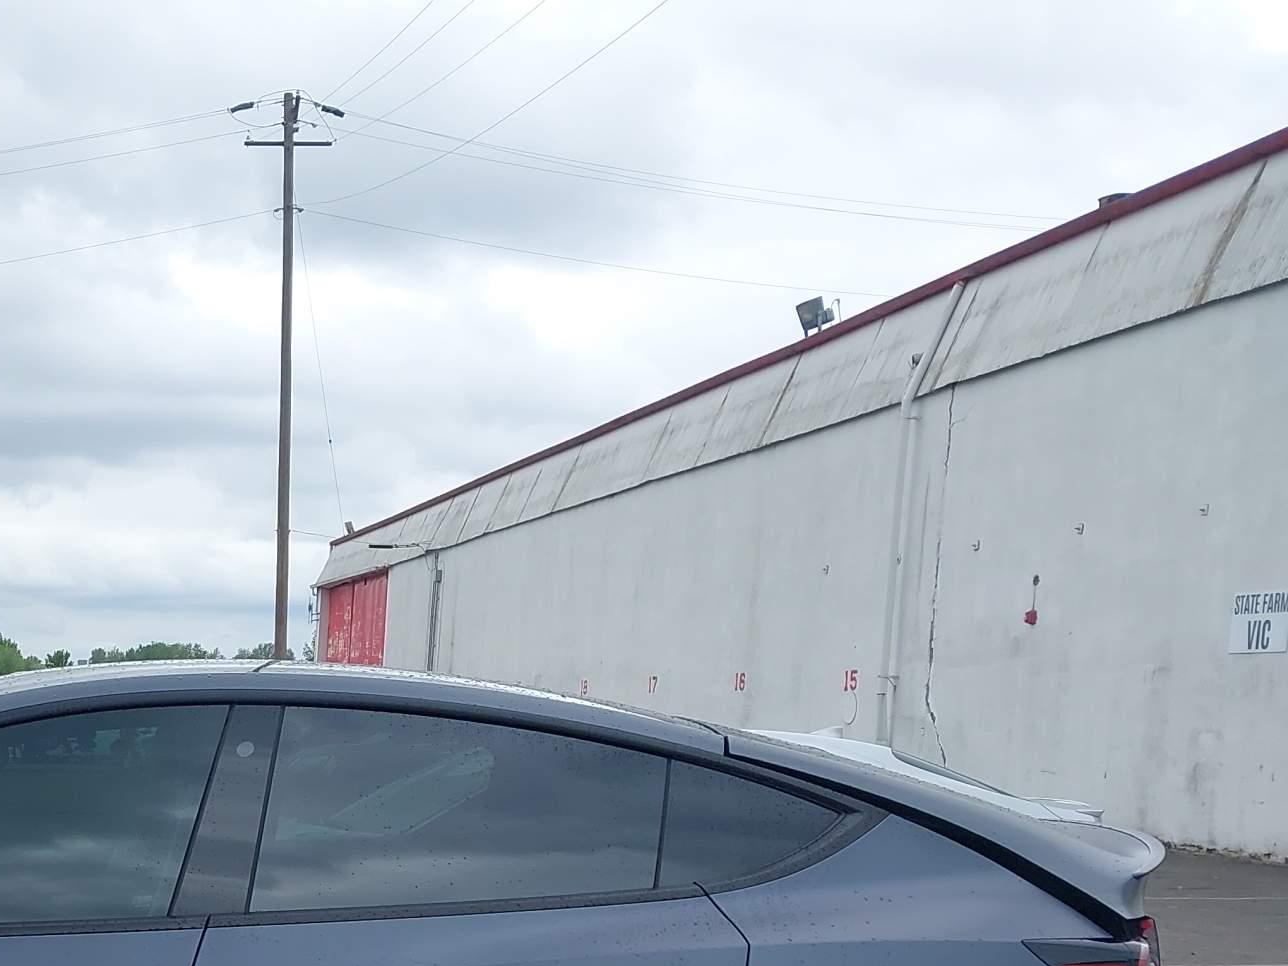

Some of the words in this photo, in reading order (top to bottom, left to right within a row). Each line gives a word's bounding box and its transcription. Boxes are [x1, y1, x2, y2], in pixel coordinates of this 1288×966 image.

[1234, 594, 1261, 615] STATE
[1247, 619, 1272, 650] VIC
[648, 676, 658, 693] 17
[734, 672, 746, 691] 16
[844, 669, 858, 691] 15
